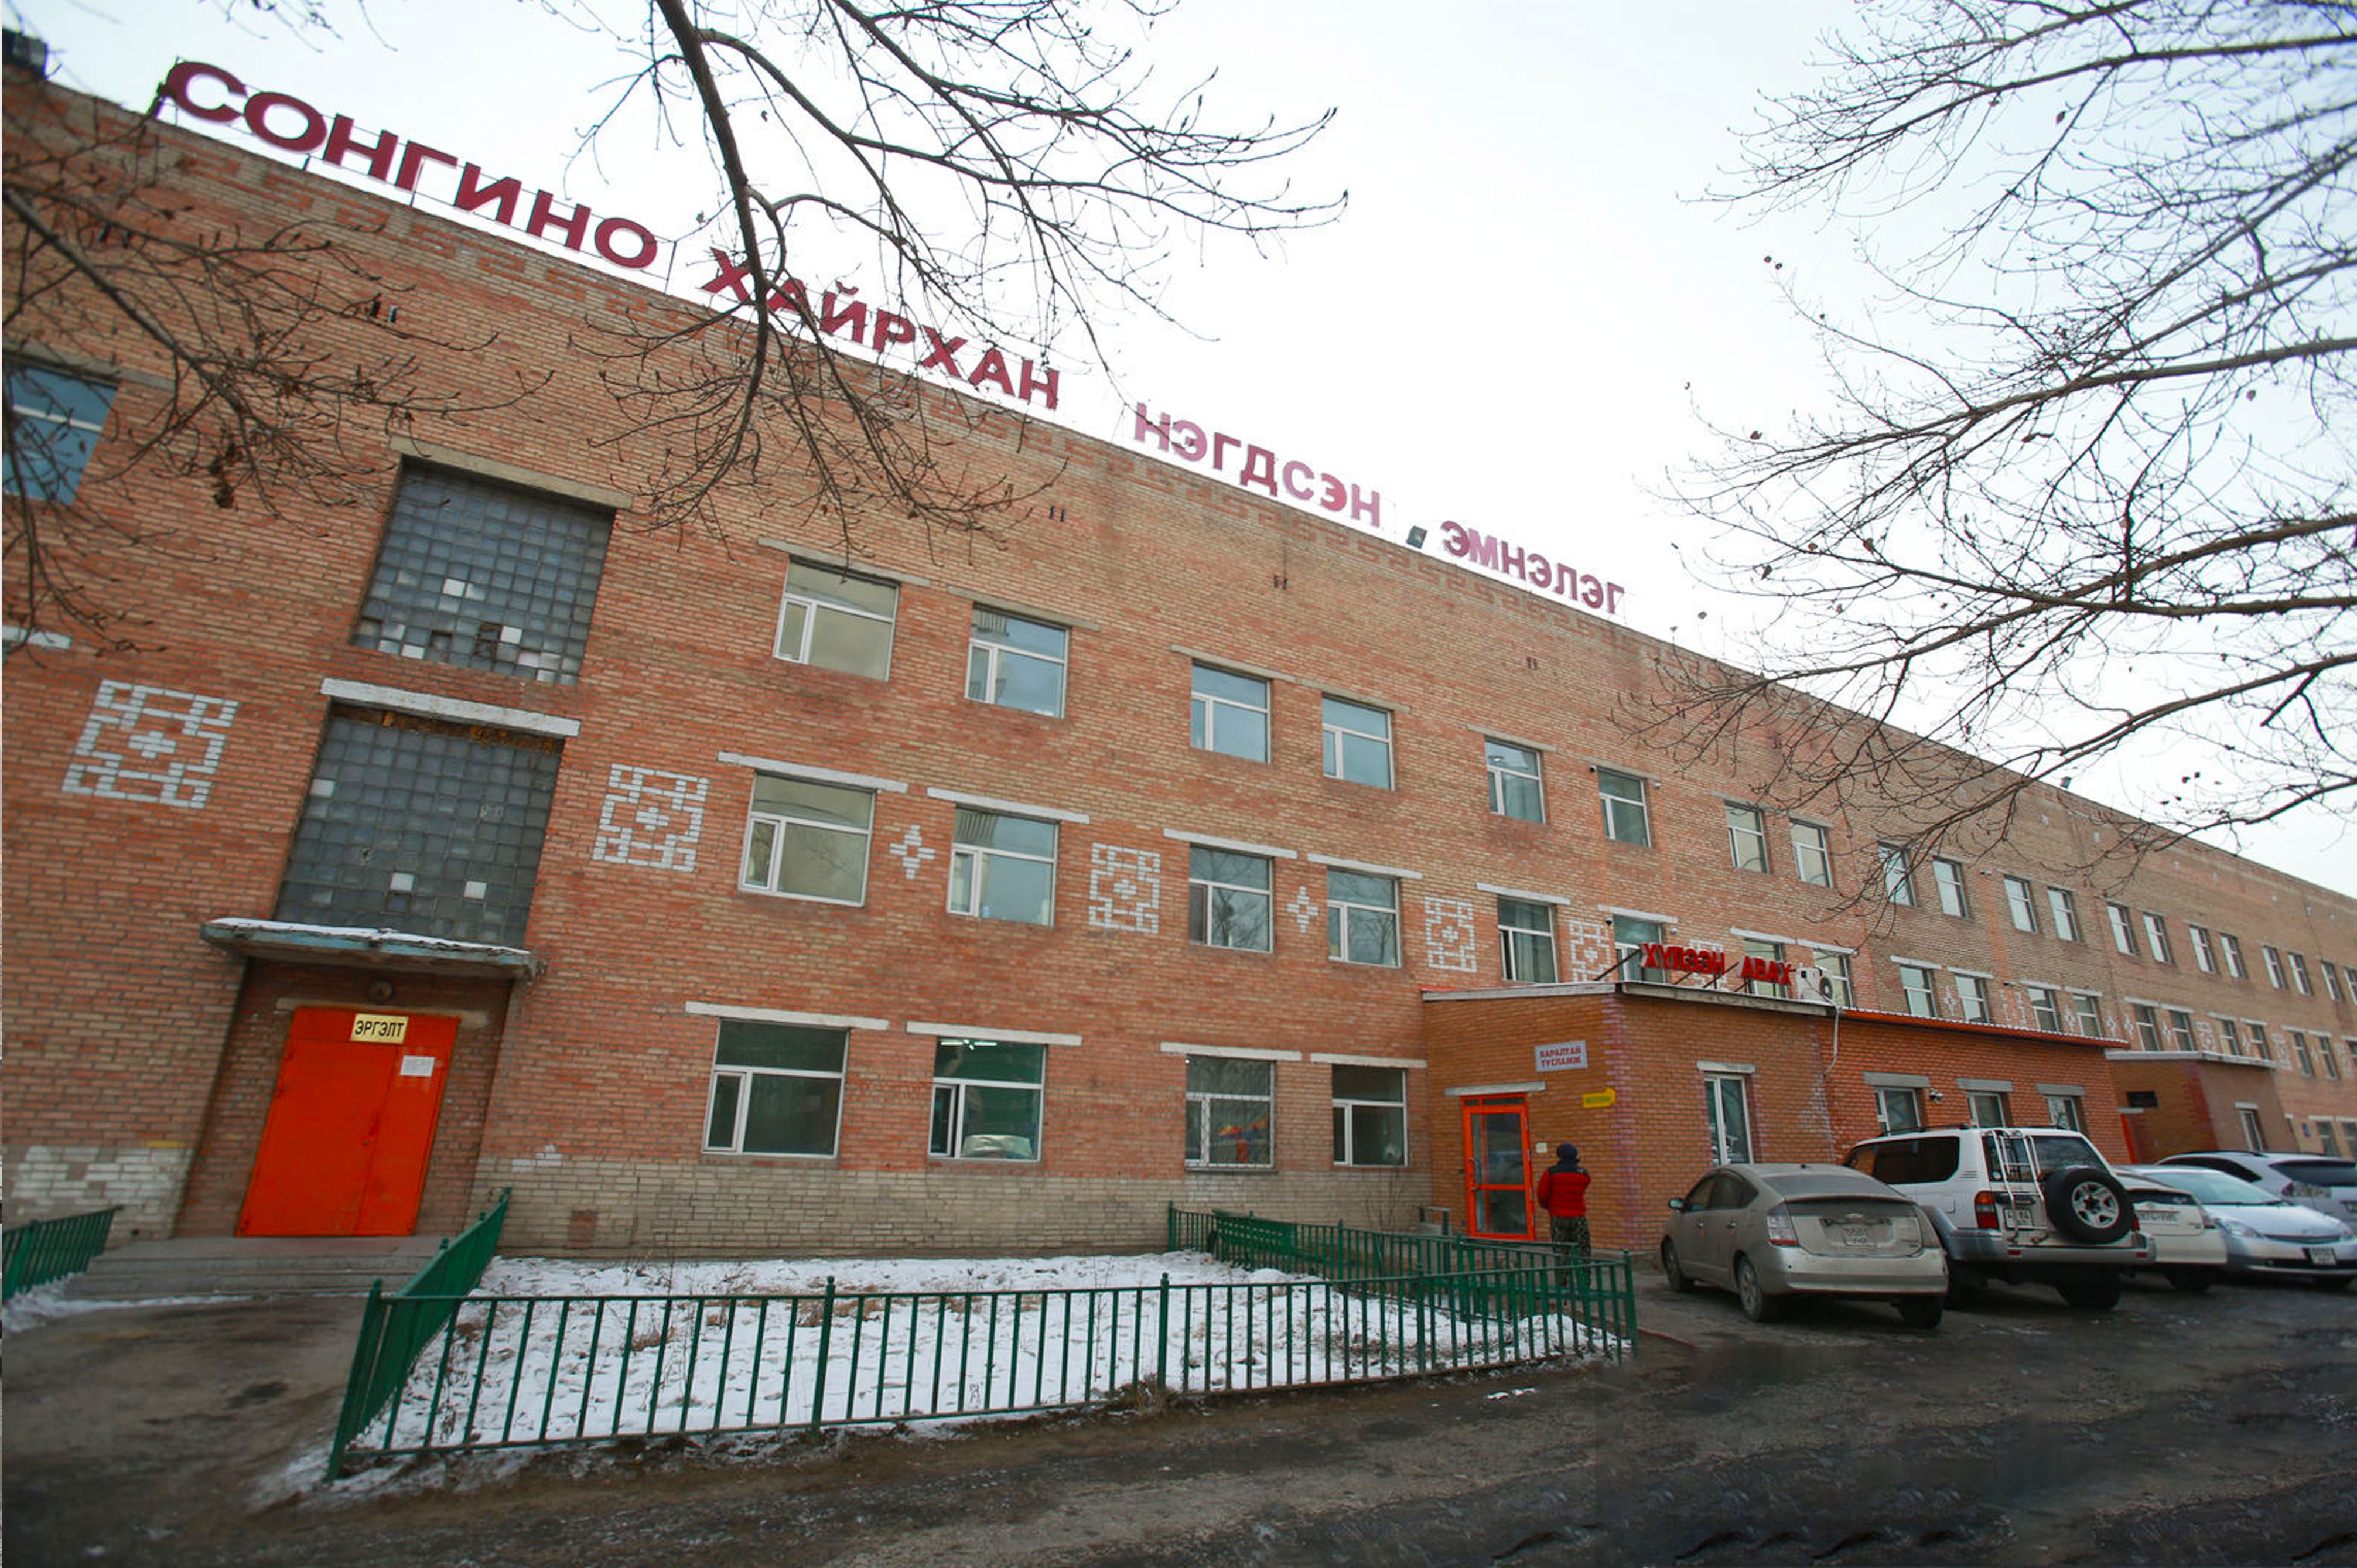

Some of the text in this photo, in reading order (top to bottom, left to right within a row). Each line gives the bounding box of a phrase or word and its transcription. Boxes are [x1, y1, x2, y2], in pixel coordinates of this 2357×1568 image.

[166, 61, 1625, 614] СОНГИНО ХАЙРХАН НЭГДСЭН ЭМНЭЛЭГ
[1740, 955, 1792, 985] АВАХ
[355, 1020, 404, 1037] ЭРГЭЛТ
